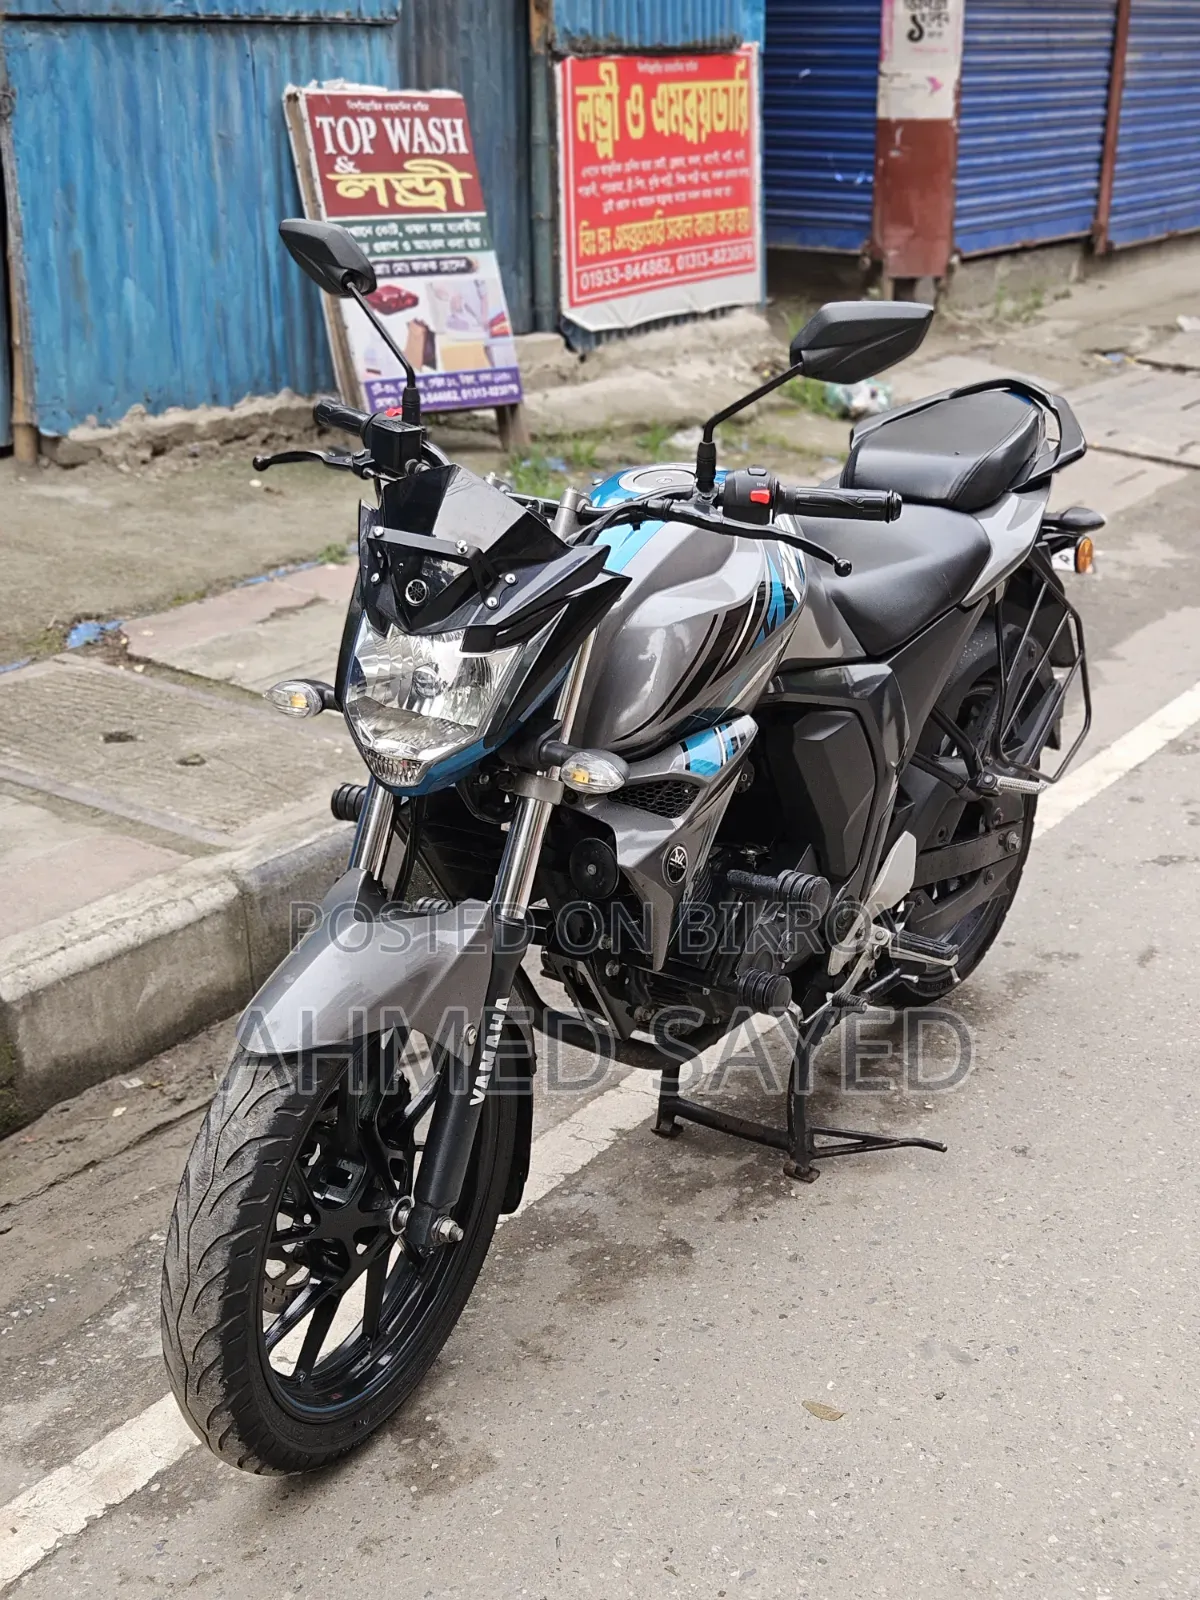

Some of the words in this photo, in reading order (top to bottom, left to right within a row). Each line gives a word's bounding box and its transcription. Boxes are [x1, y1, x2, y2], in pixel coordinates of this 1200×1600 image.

[315, 115, 378, 155] TOP
[382, 116, 469, 155] WASH
[625, 84, 646, 140] ও
[334, 155, 361, 174] &
[469, 997, 510, 1106] YAMAHA
